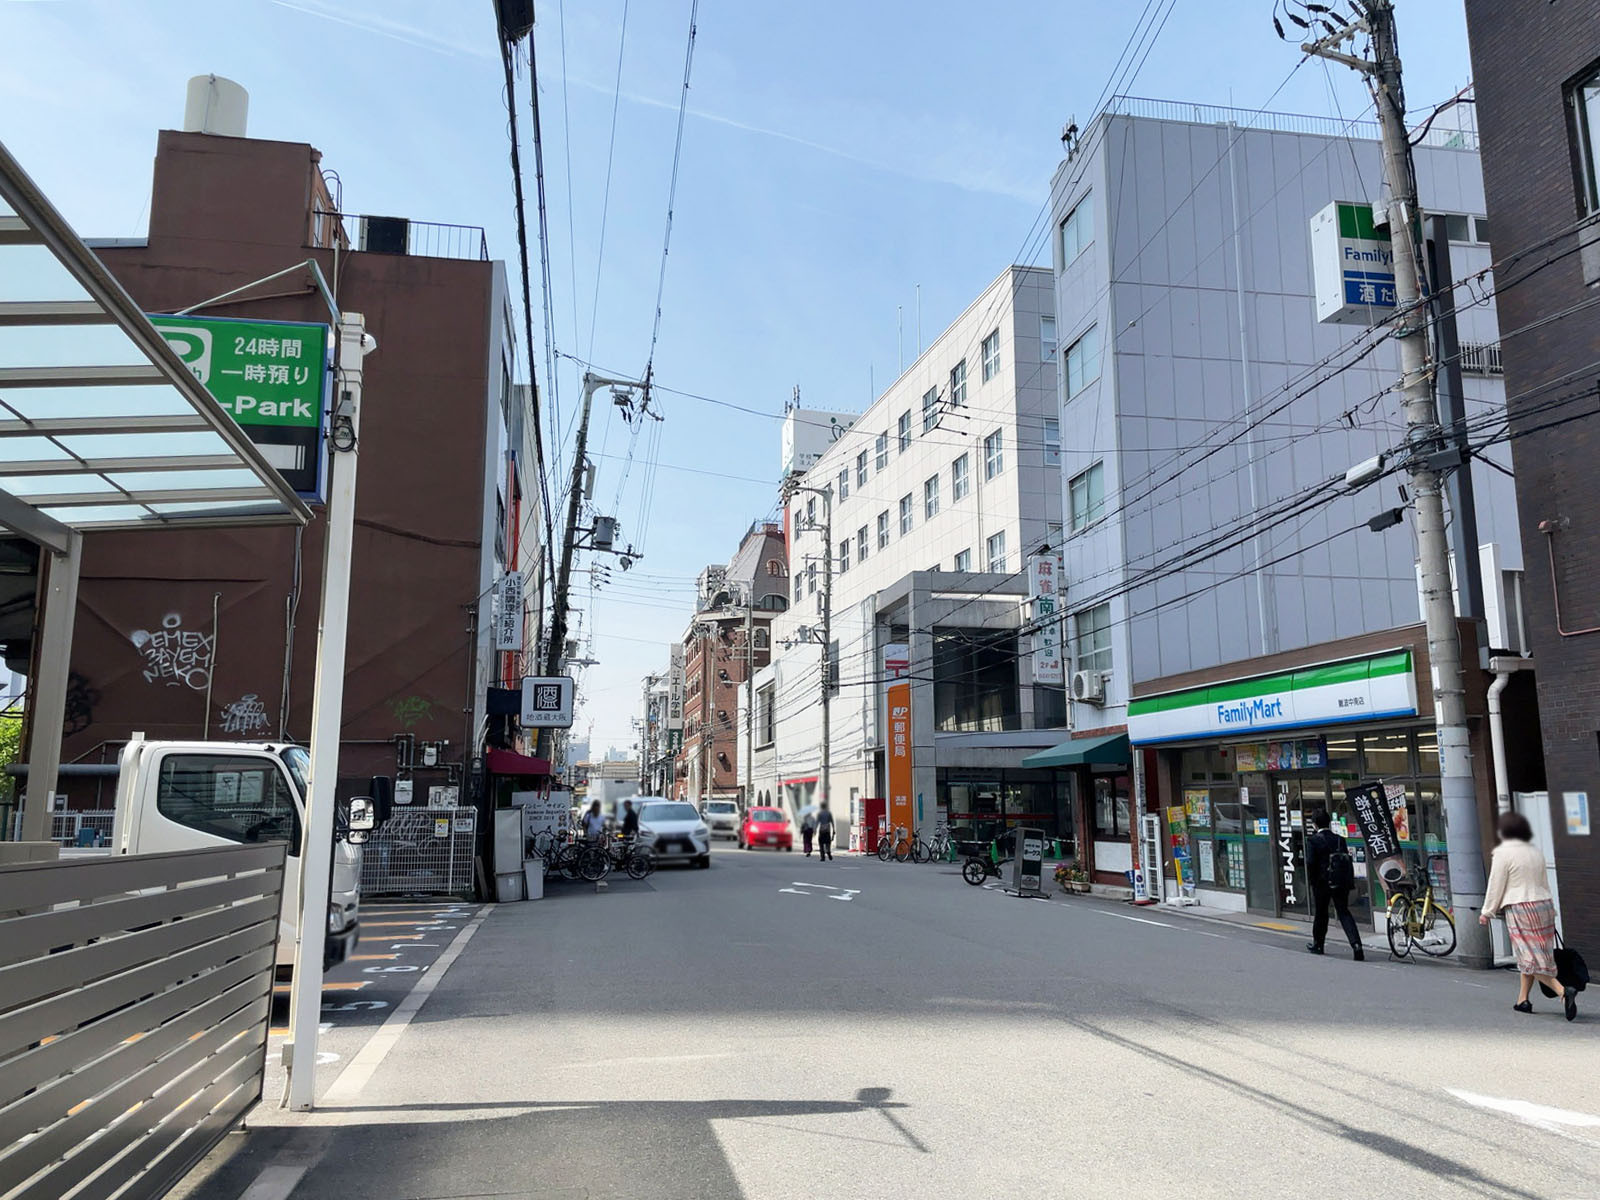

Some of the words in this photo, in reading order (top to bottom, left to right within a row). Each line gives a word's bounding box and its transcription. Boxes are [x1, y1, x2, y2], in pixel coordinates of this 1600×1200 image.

[1359, 284, 1376, 303] 酒
[234, 337, 302, 359] 24時間
[221, 364, 310, 386] 一時預り
[1217, 698, 1283, 725] FamilyMart
[1277, 780, 1297, 905] FamilyMart
